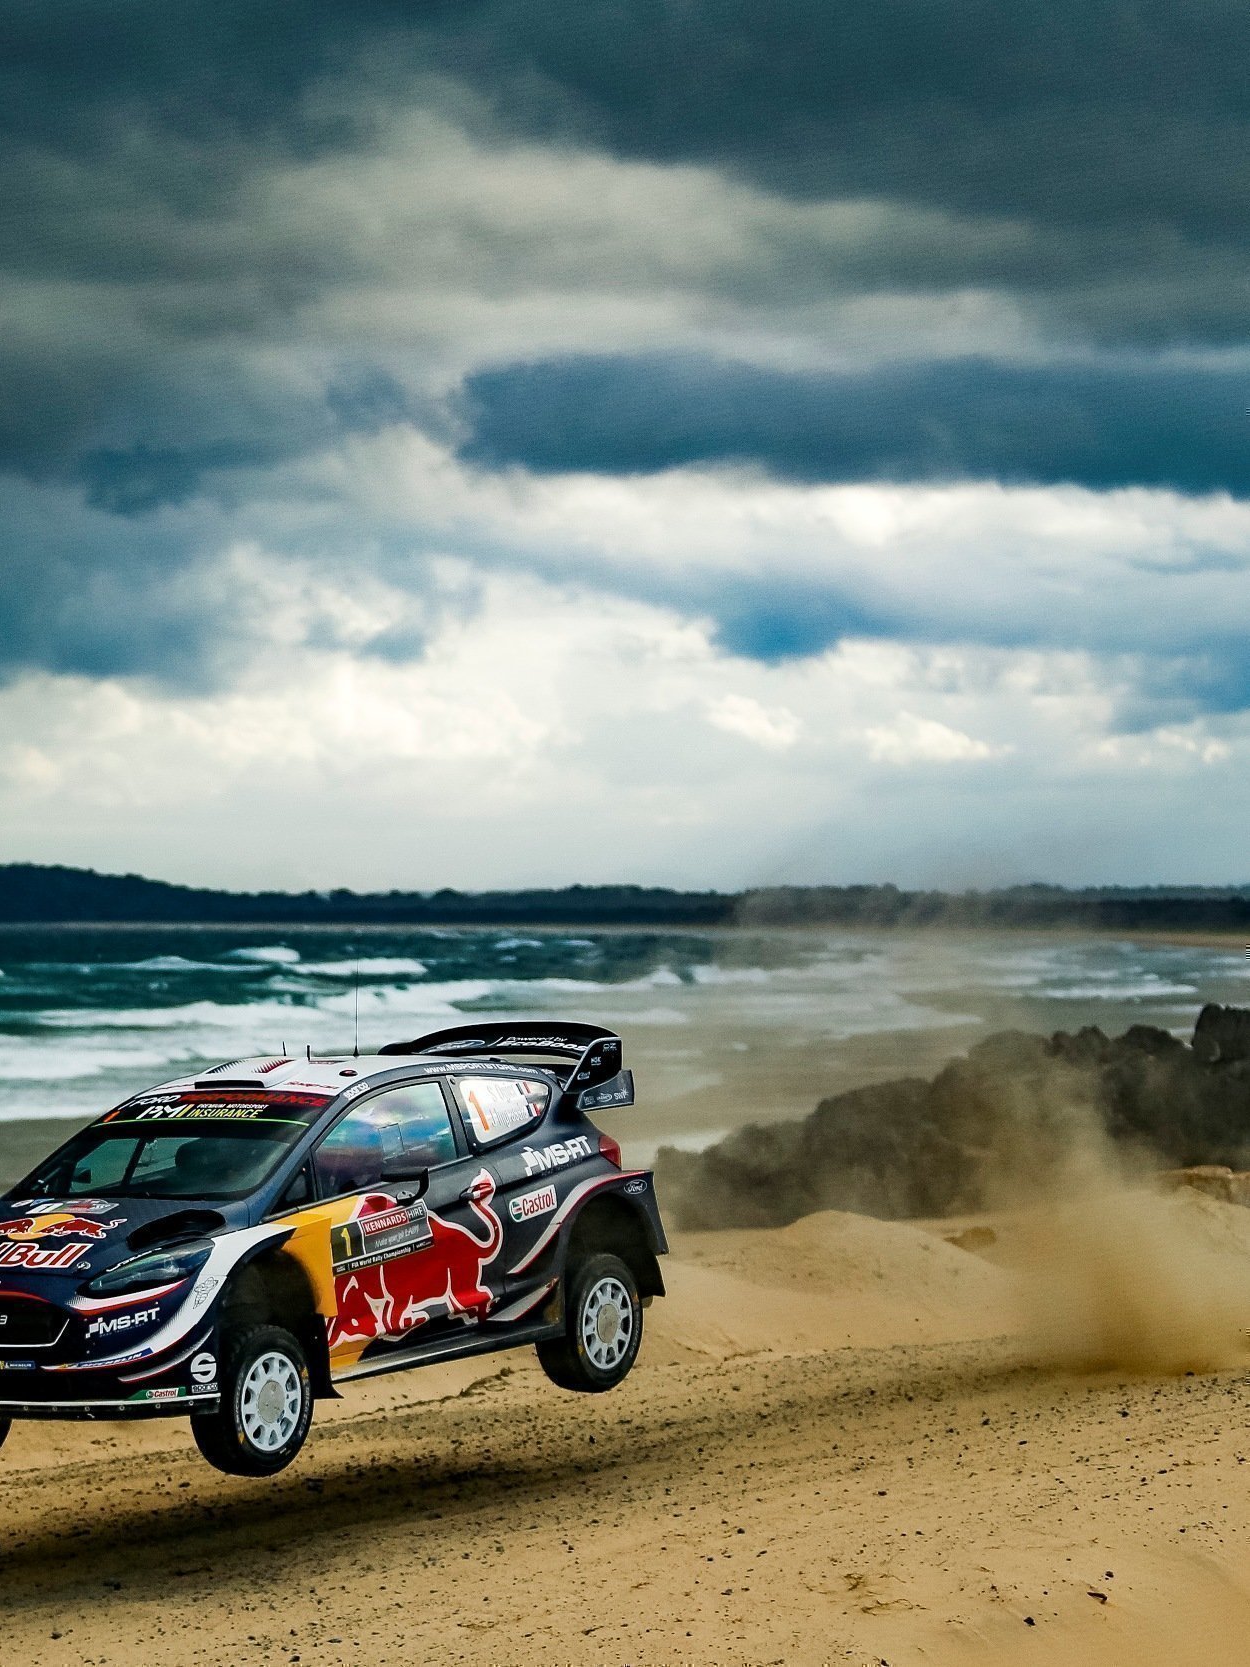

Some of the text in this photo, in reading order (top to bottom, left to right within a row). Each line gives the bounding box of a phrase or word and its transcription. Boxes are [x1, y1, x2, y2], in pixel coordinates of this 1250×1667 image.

[130, 1092, 328, 1108] FORD PERFORMANCE
[226, 1103, 269, 1111] MOTORSPORT
[188, 1108, 264, 1119] INSURANCE
[626, 1182, 643, 1195] Ford
[522, 1188, 556, 1216] Castrol
[364, 1206, 423, 1232] KENNARDS HIRE
[340, 1227, 352, 1257] 1
[351, 1261, 359, 1269] FIA
[359, 1257, 372, 1267] World
[372, 1255, 383, 1264] Rally
[383, 1246, 411, 1259] Championship
[154, 1389, 178, 1398] Castrol
